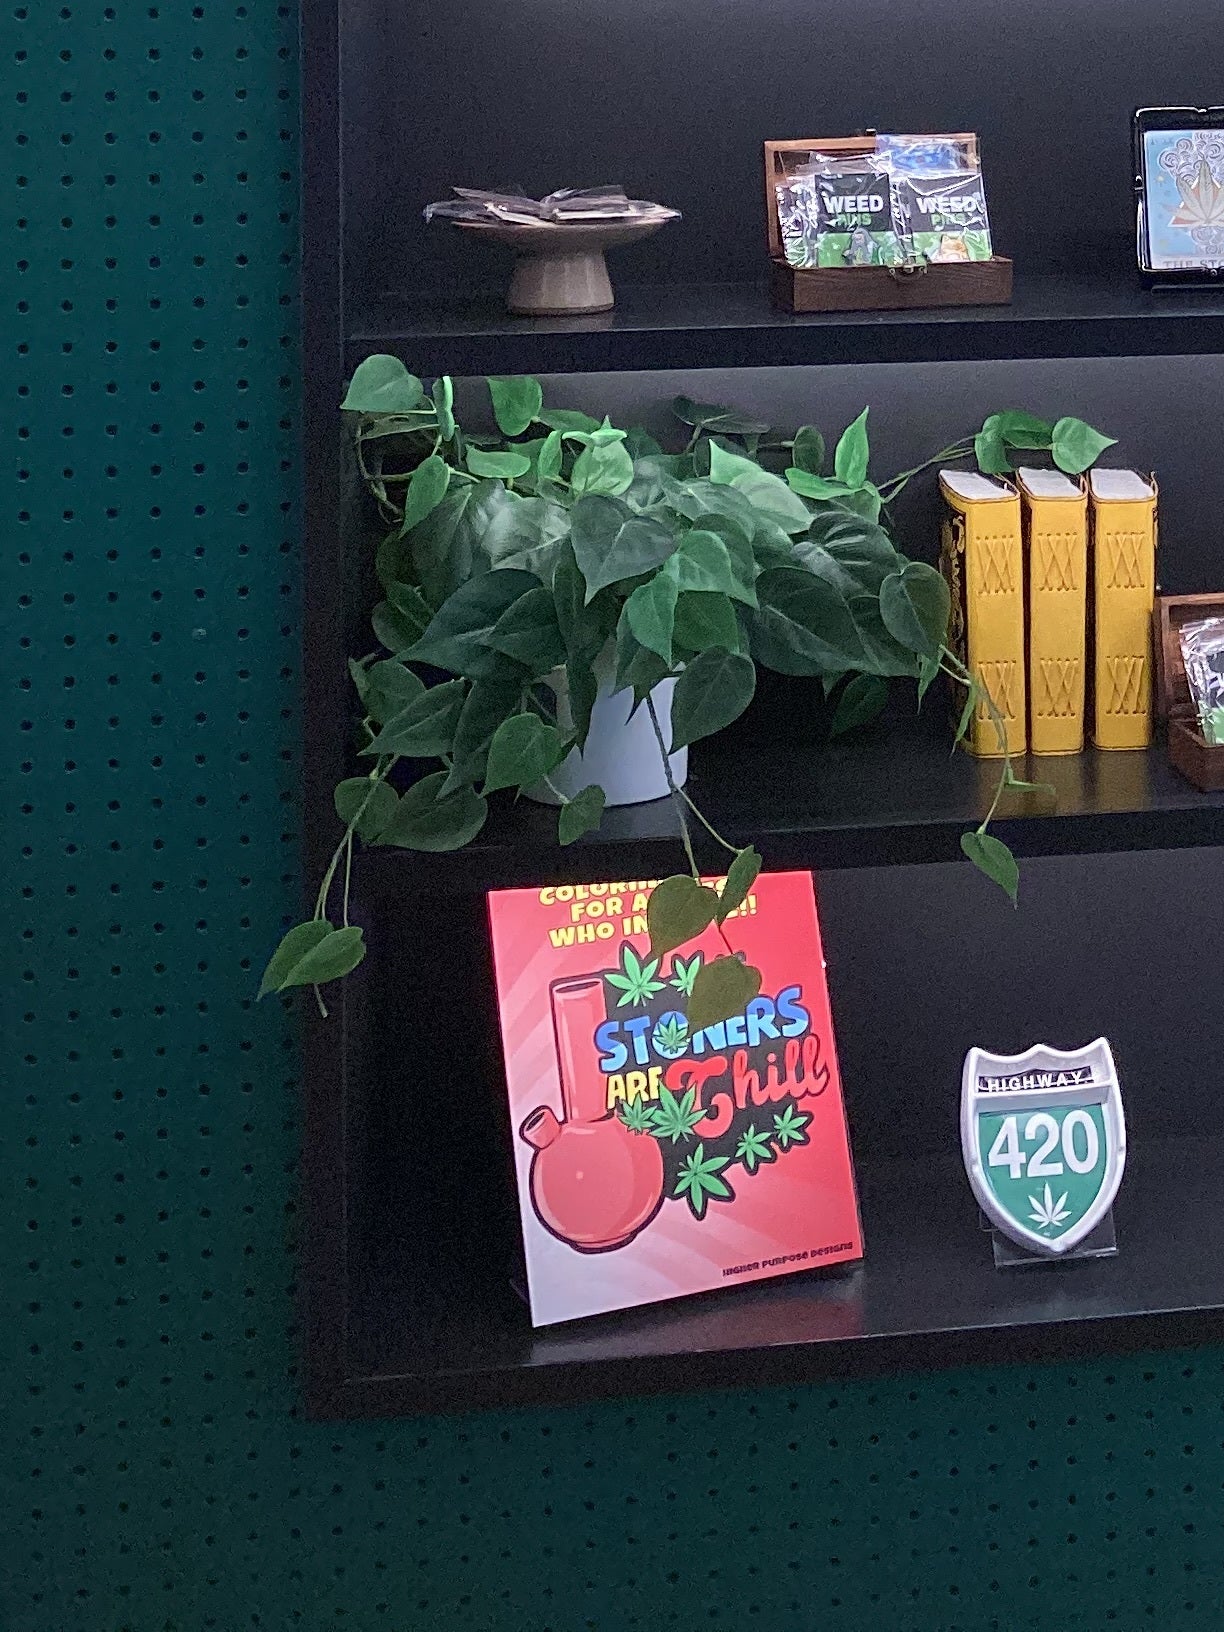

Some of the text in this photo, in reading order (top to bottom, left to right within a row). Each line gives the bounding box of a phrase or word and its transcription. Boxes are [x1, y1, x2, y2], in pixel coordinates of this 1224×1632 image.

[822, 195, 884, 214] WEED
[916, 196, 977, 214] WEED
[570, 896, 624, 923] FOR
[549, 921, 615, 948] WHO
[595, 985, 809, 1072] STONERS
[987, 1070, 1083, 1093] HIGHWAY
[987, 1109, 1099, 1180] 420
